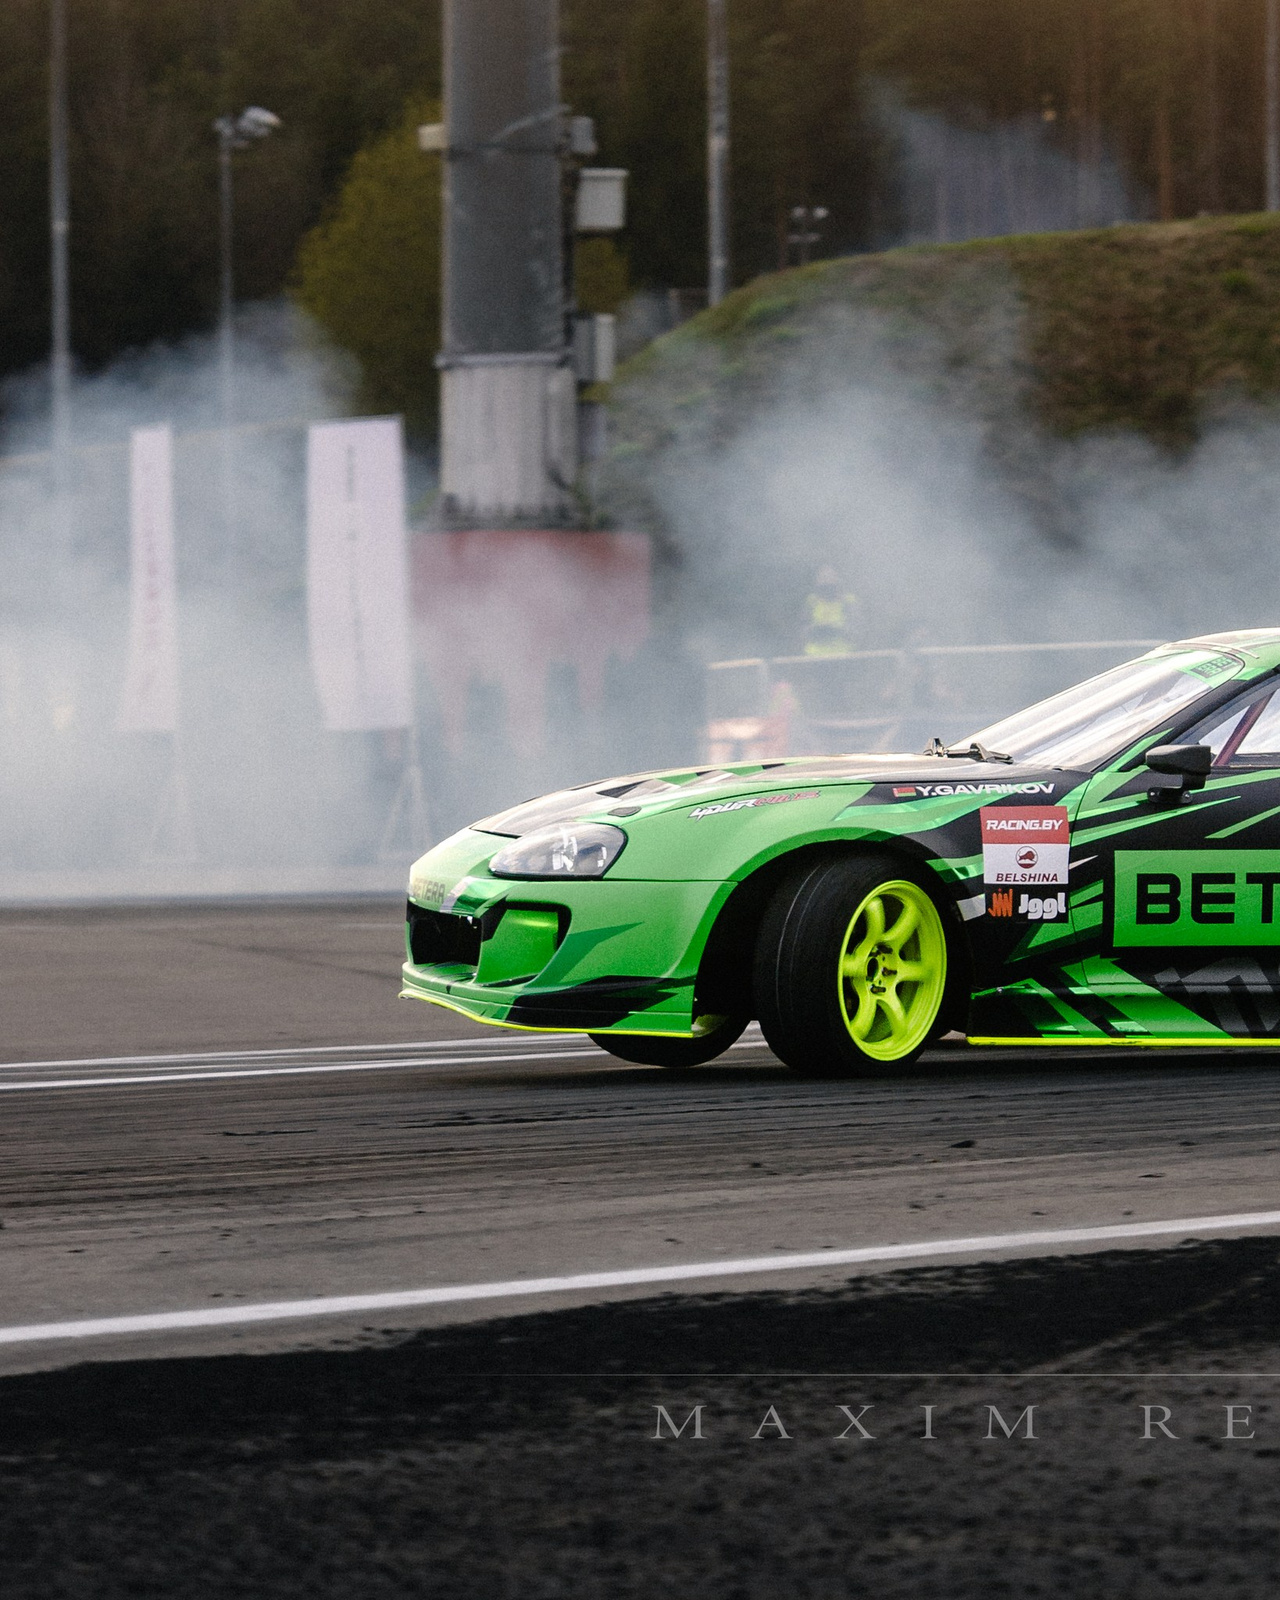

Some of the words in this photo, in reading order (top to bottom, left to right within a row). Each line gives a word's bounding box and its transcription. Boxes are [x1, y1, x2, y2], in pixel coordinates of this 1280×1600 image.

[916, 783, 1055, 796] Y.GAVRIKOV
[986, 819, 1064, 831] RACING.BY
[996, 872, 1059, 883] BELSHINA
